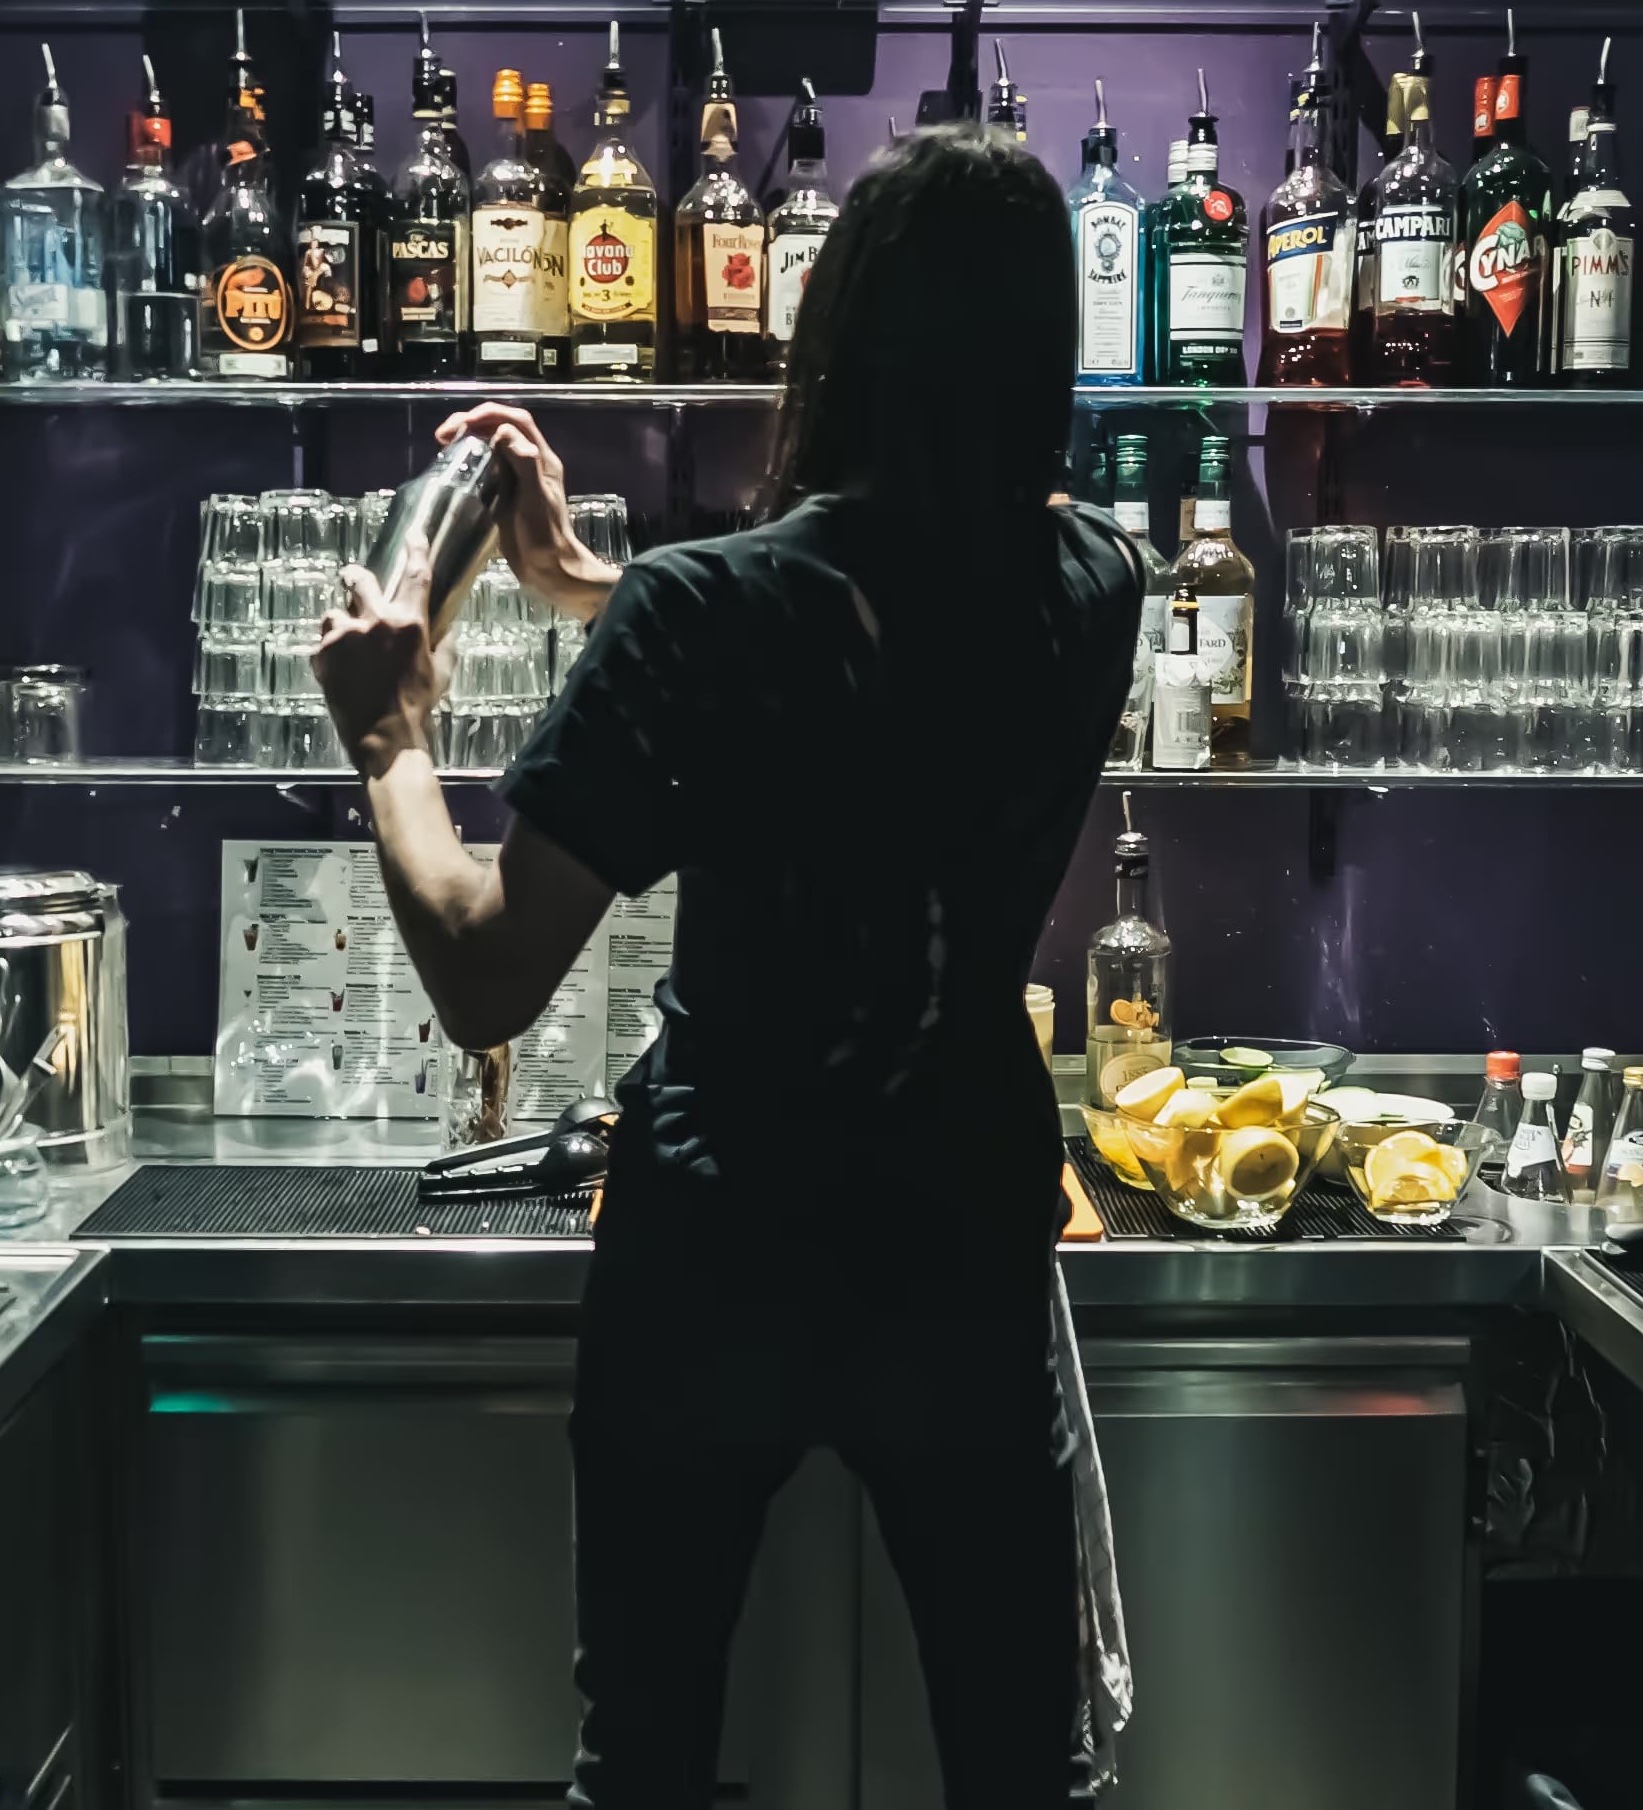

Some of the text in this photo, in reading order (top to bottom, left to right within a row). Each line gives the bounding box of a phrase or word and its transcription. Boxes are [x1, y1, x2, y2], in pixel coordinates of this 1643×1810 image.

[1376, 215, 1451, 241] CAMPARI
[587, 258, 623, 276] Club
[780, 251, 805, 274] JIM
